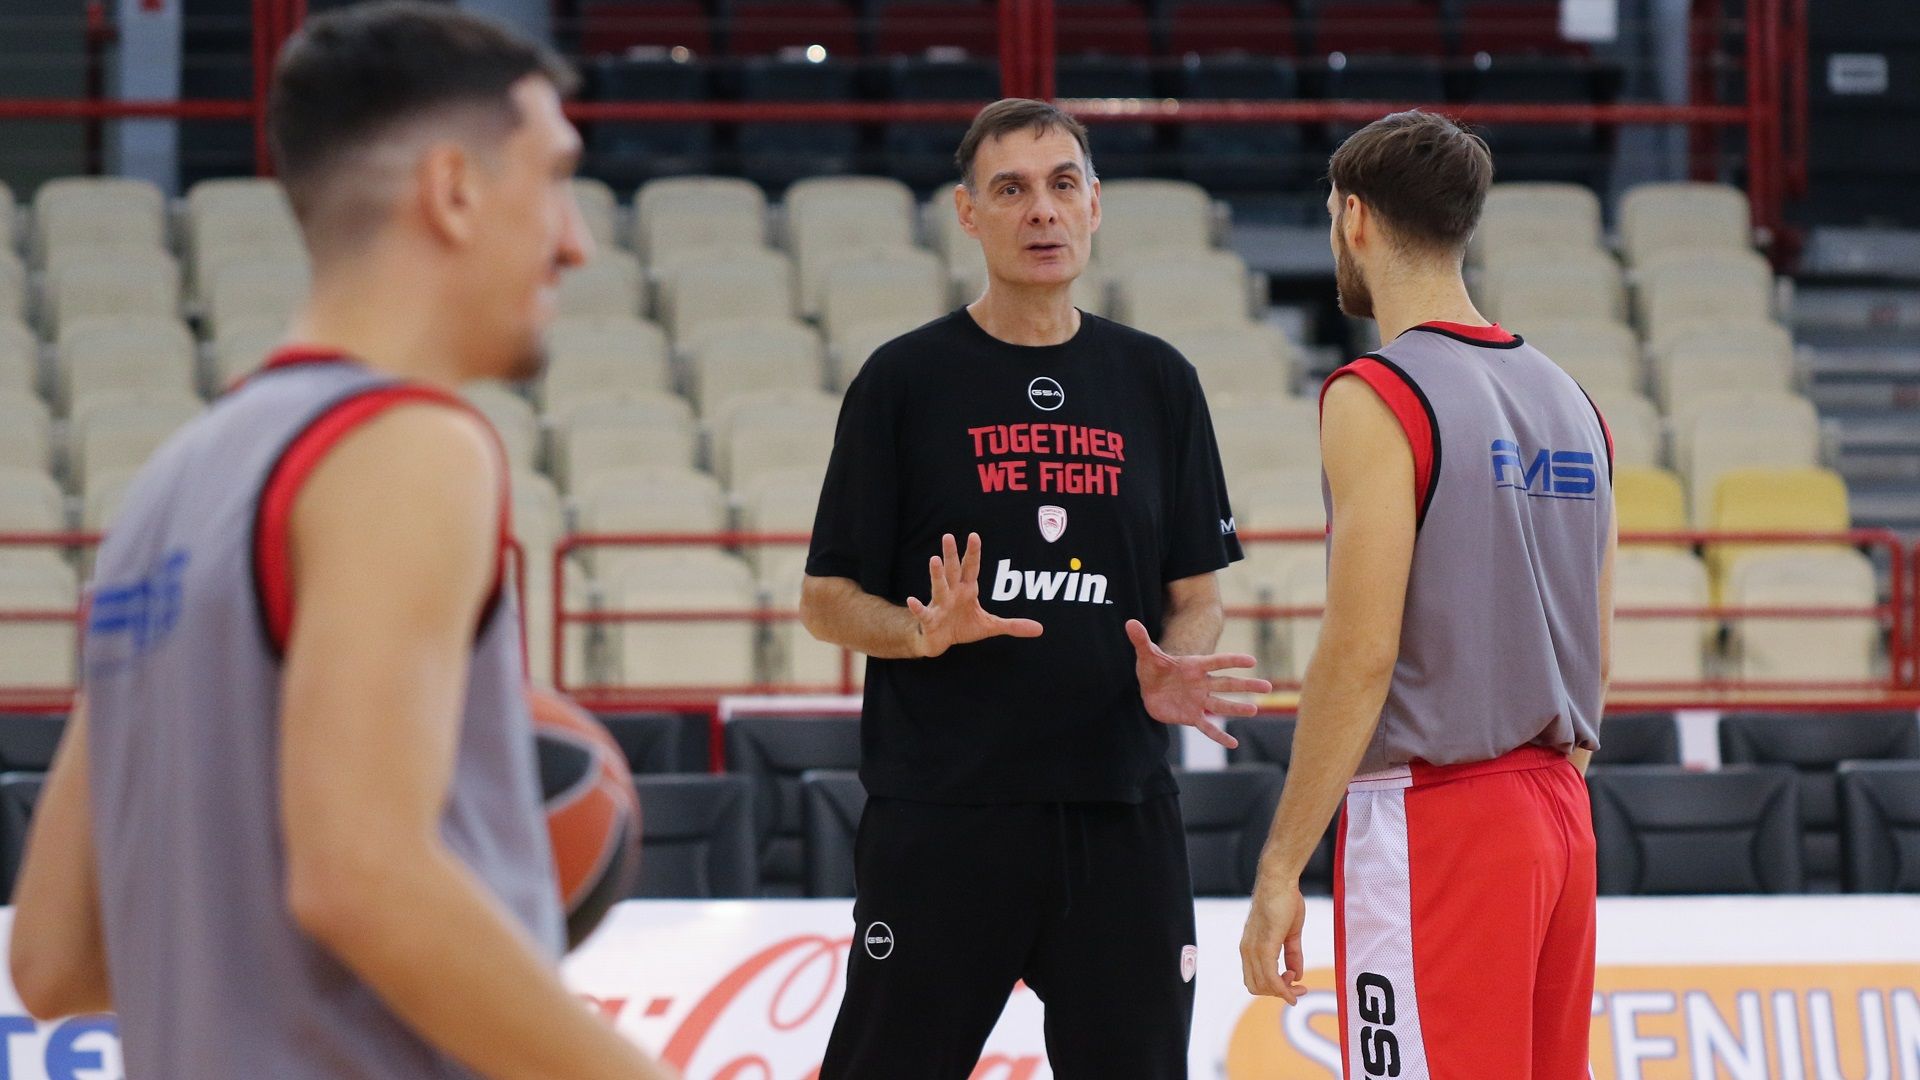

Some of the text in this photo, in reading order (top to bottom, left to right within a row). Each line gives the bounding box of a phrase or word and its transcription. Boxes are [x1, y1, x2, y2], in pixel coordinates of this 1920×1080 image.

[1031, 389, 1062, 397] GSA
[967, 423, 1126, 462] TOGETHER
[977, 460, 1122, 496] WE FIGHT
[867, 936, 892, 944] GSA
[1356, 972, 1401, 1080] GS
